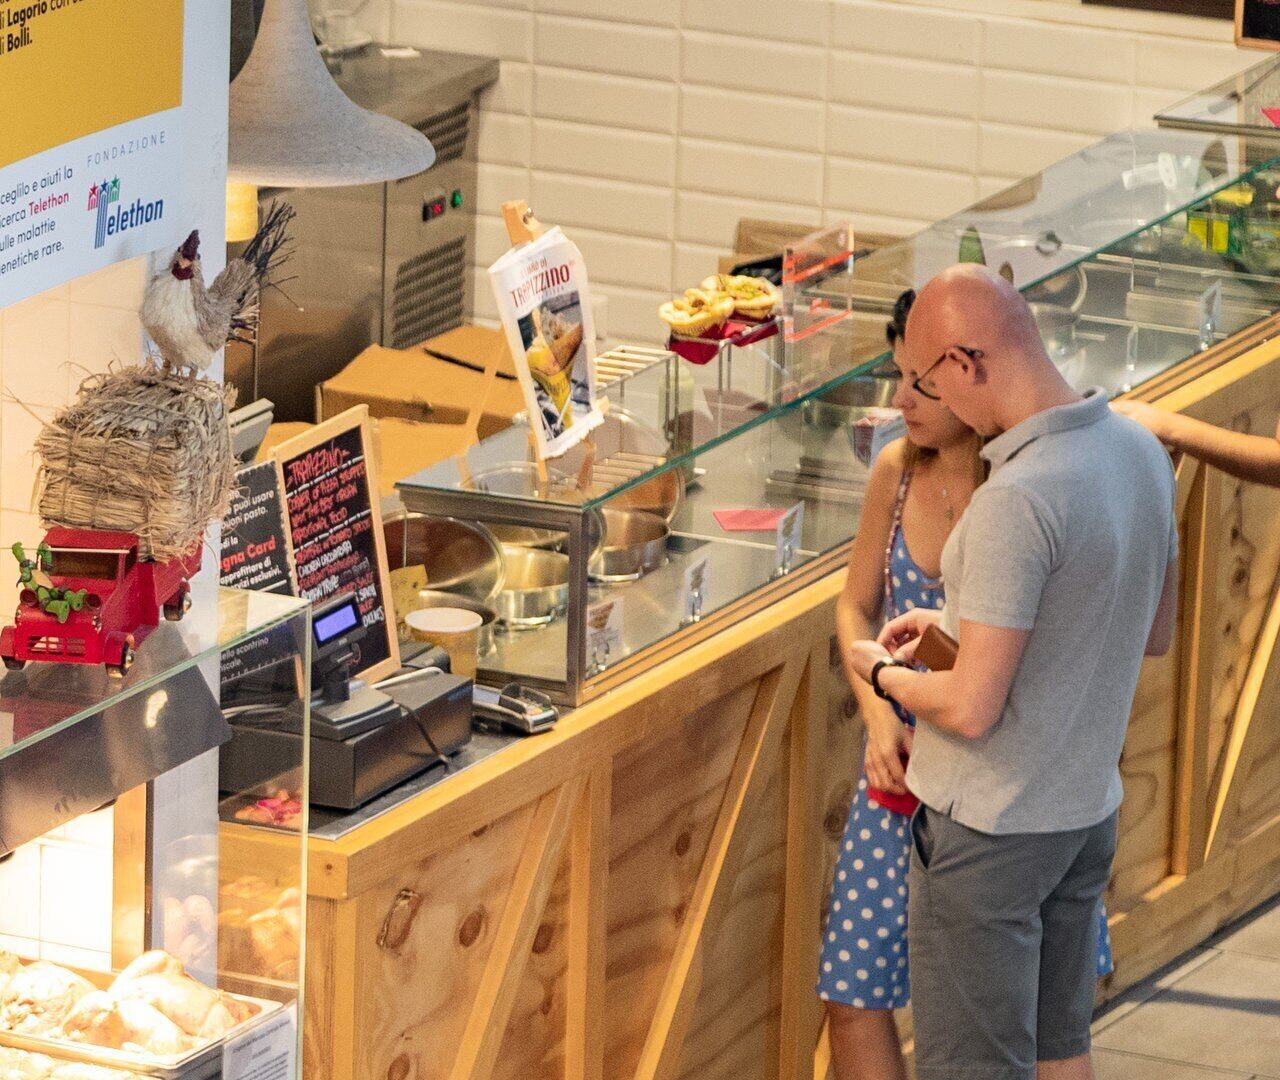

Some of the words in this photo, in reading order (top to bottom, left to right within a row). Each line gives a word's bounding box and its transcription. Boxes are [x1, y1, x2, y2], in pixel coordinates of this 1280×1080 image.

[7, 1, 48, 27] Lagorio
[7, 27, 33, 52] Bolli.
[87, 130, 166, 167] FONDAZIONE
[32, 181, 38, 192] e
[40, 168, 62, 190] aiuti
[64, 165, 73, 181] la
[28, 192, 70, 216] Telethon
[17, 218, 56, 244] malattie
[41, 239, 65, 257] rare.
[233, 499, 251, 515] puoi
[247, 535, 276, 559] Card
